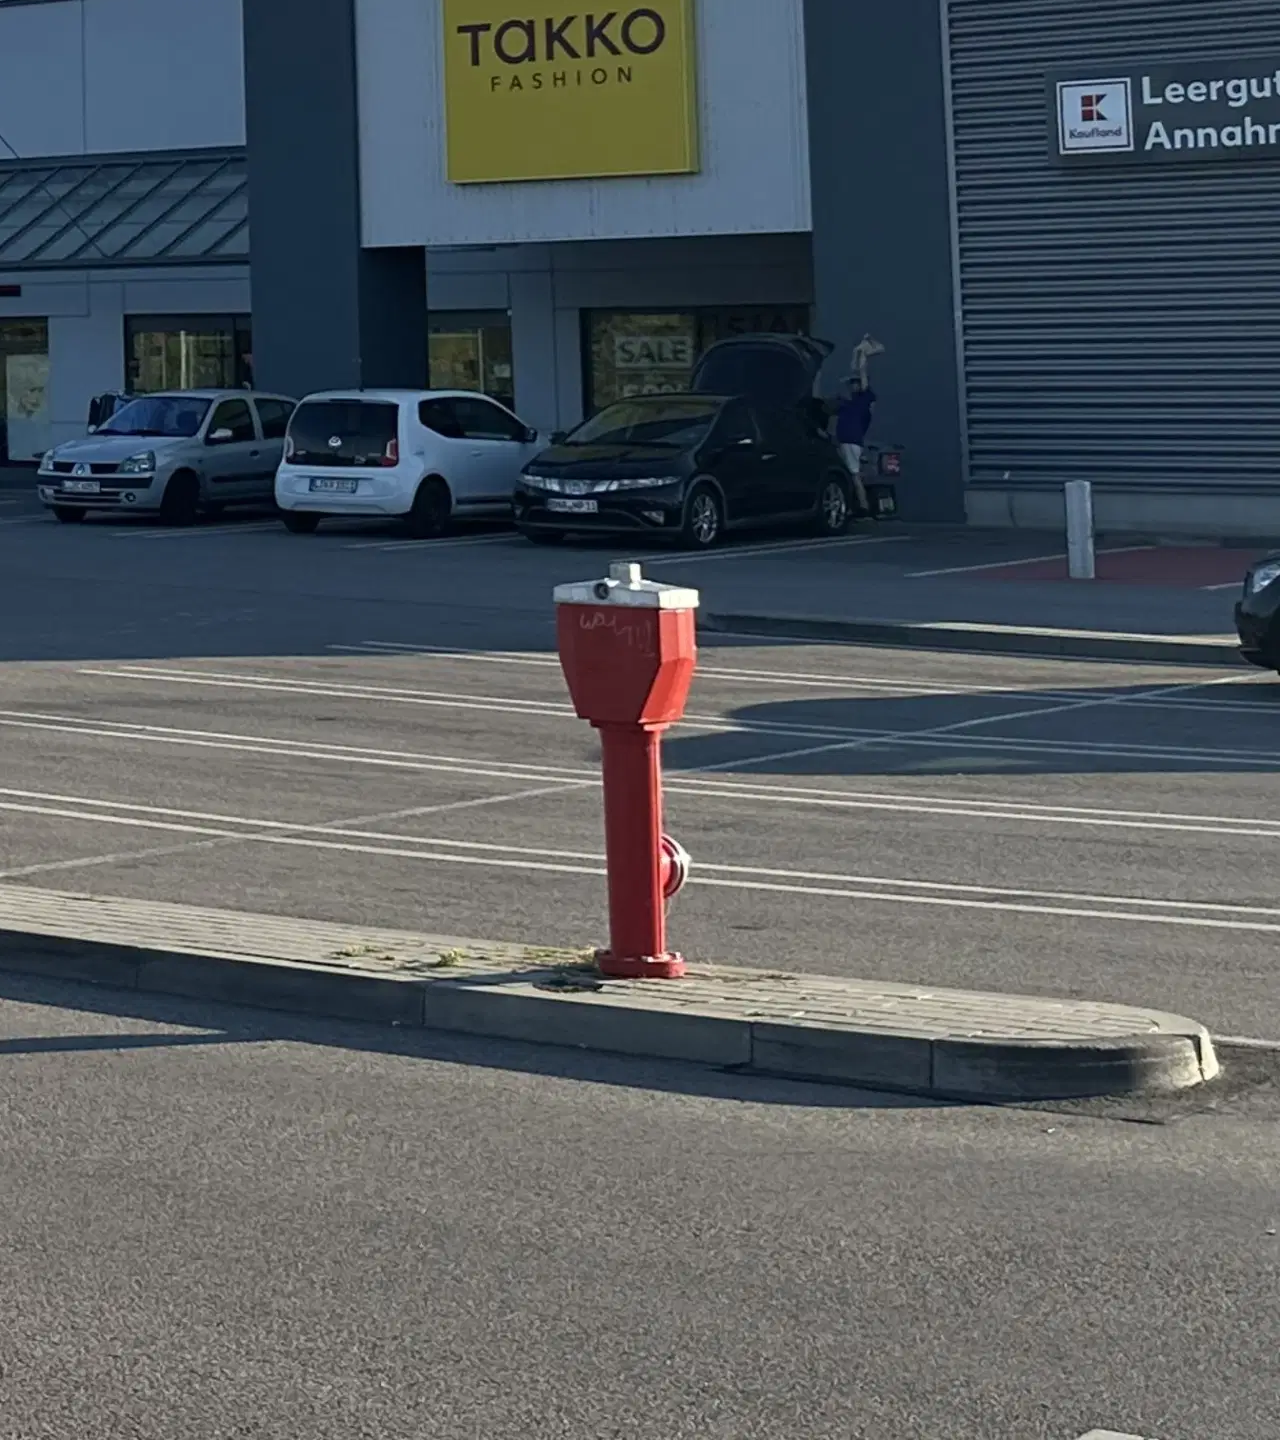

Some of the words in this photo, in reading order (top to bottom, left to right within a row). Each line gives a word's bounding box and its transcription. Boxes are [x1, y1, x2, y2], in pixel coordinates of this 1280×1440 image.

[490, 66, 633, 93] FASHION
[1068, 126, 1123, 140] Kaufland
[618, 339, 688, 364] SALE
